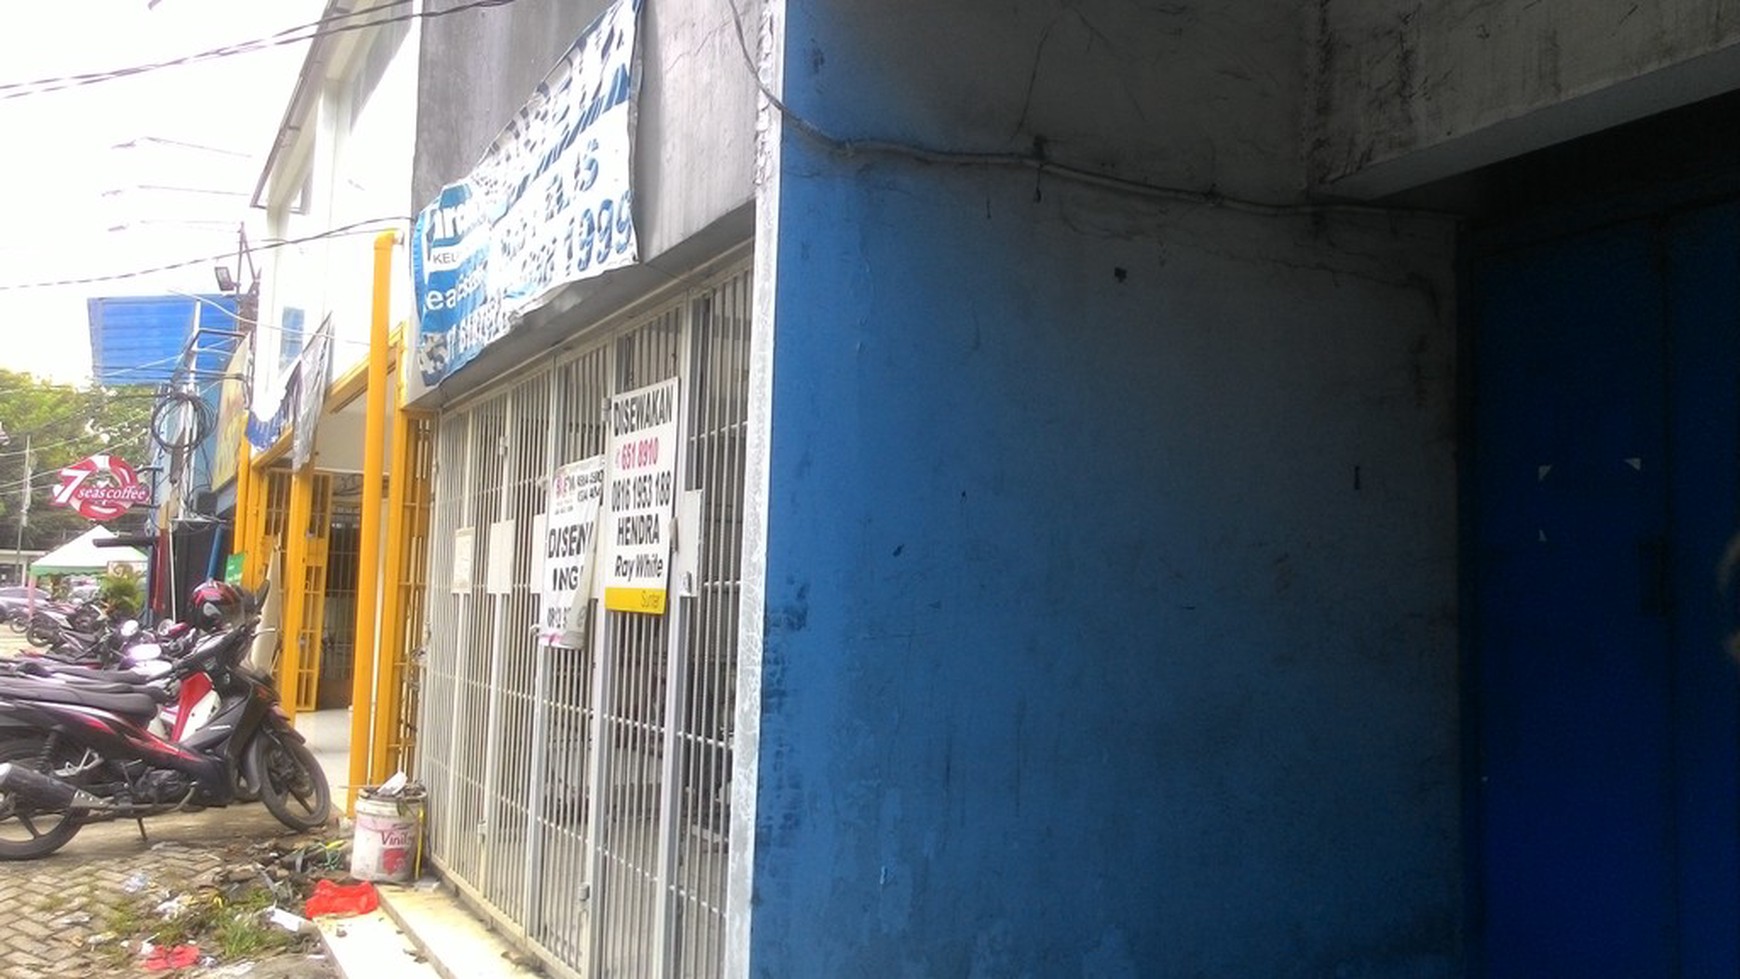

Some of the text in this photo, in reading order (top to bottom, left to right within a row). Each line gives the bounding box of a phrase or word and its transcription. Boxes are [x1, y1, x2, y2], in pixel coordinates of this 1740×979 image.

[564, 190, 632, 277] 1999
[614, 384, 674, 437] DISEWAKAN
[622, 437, 659, 471] 651 8910
[55, 468, 91, 504] 7
[611, 478, 631, 512] 0816
[633, 473, 652, 510] 1953
[655, 470, 671, 507] 188
[617, 513, 660, 546] HENDRA
[615, 553, 664, 582] Ray White
